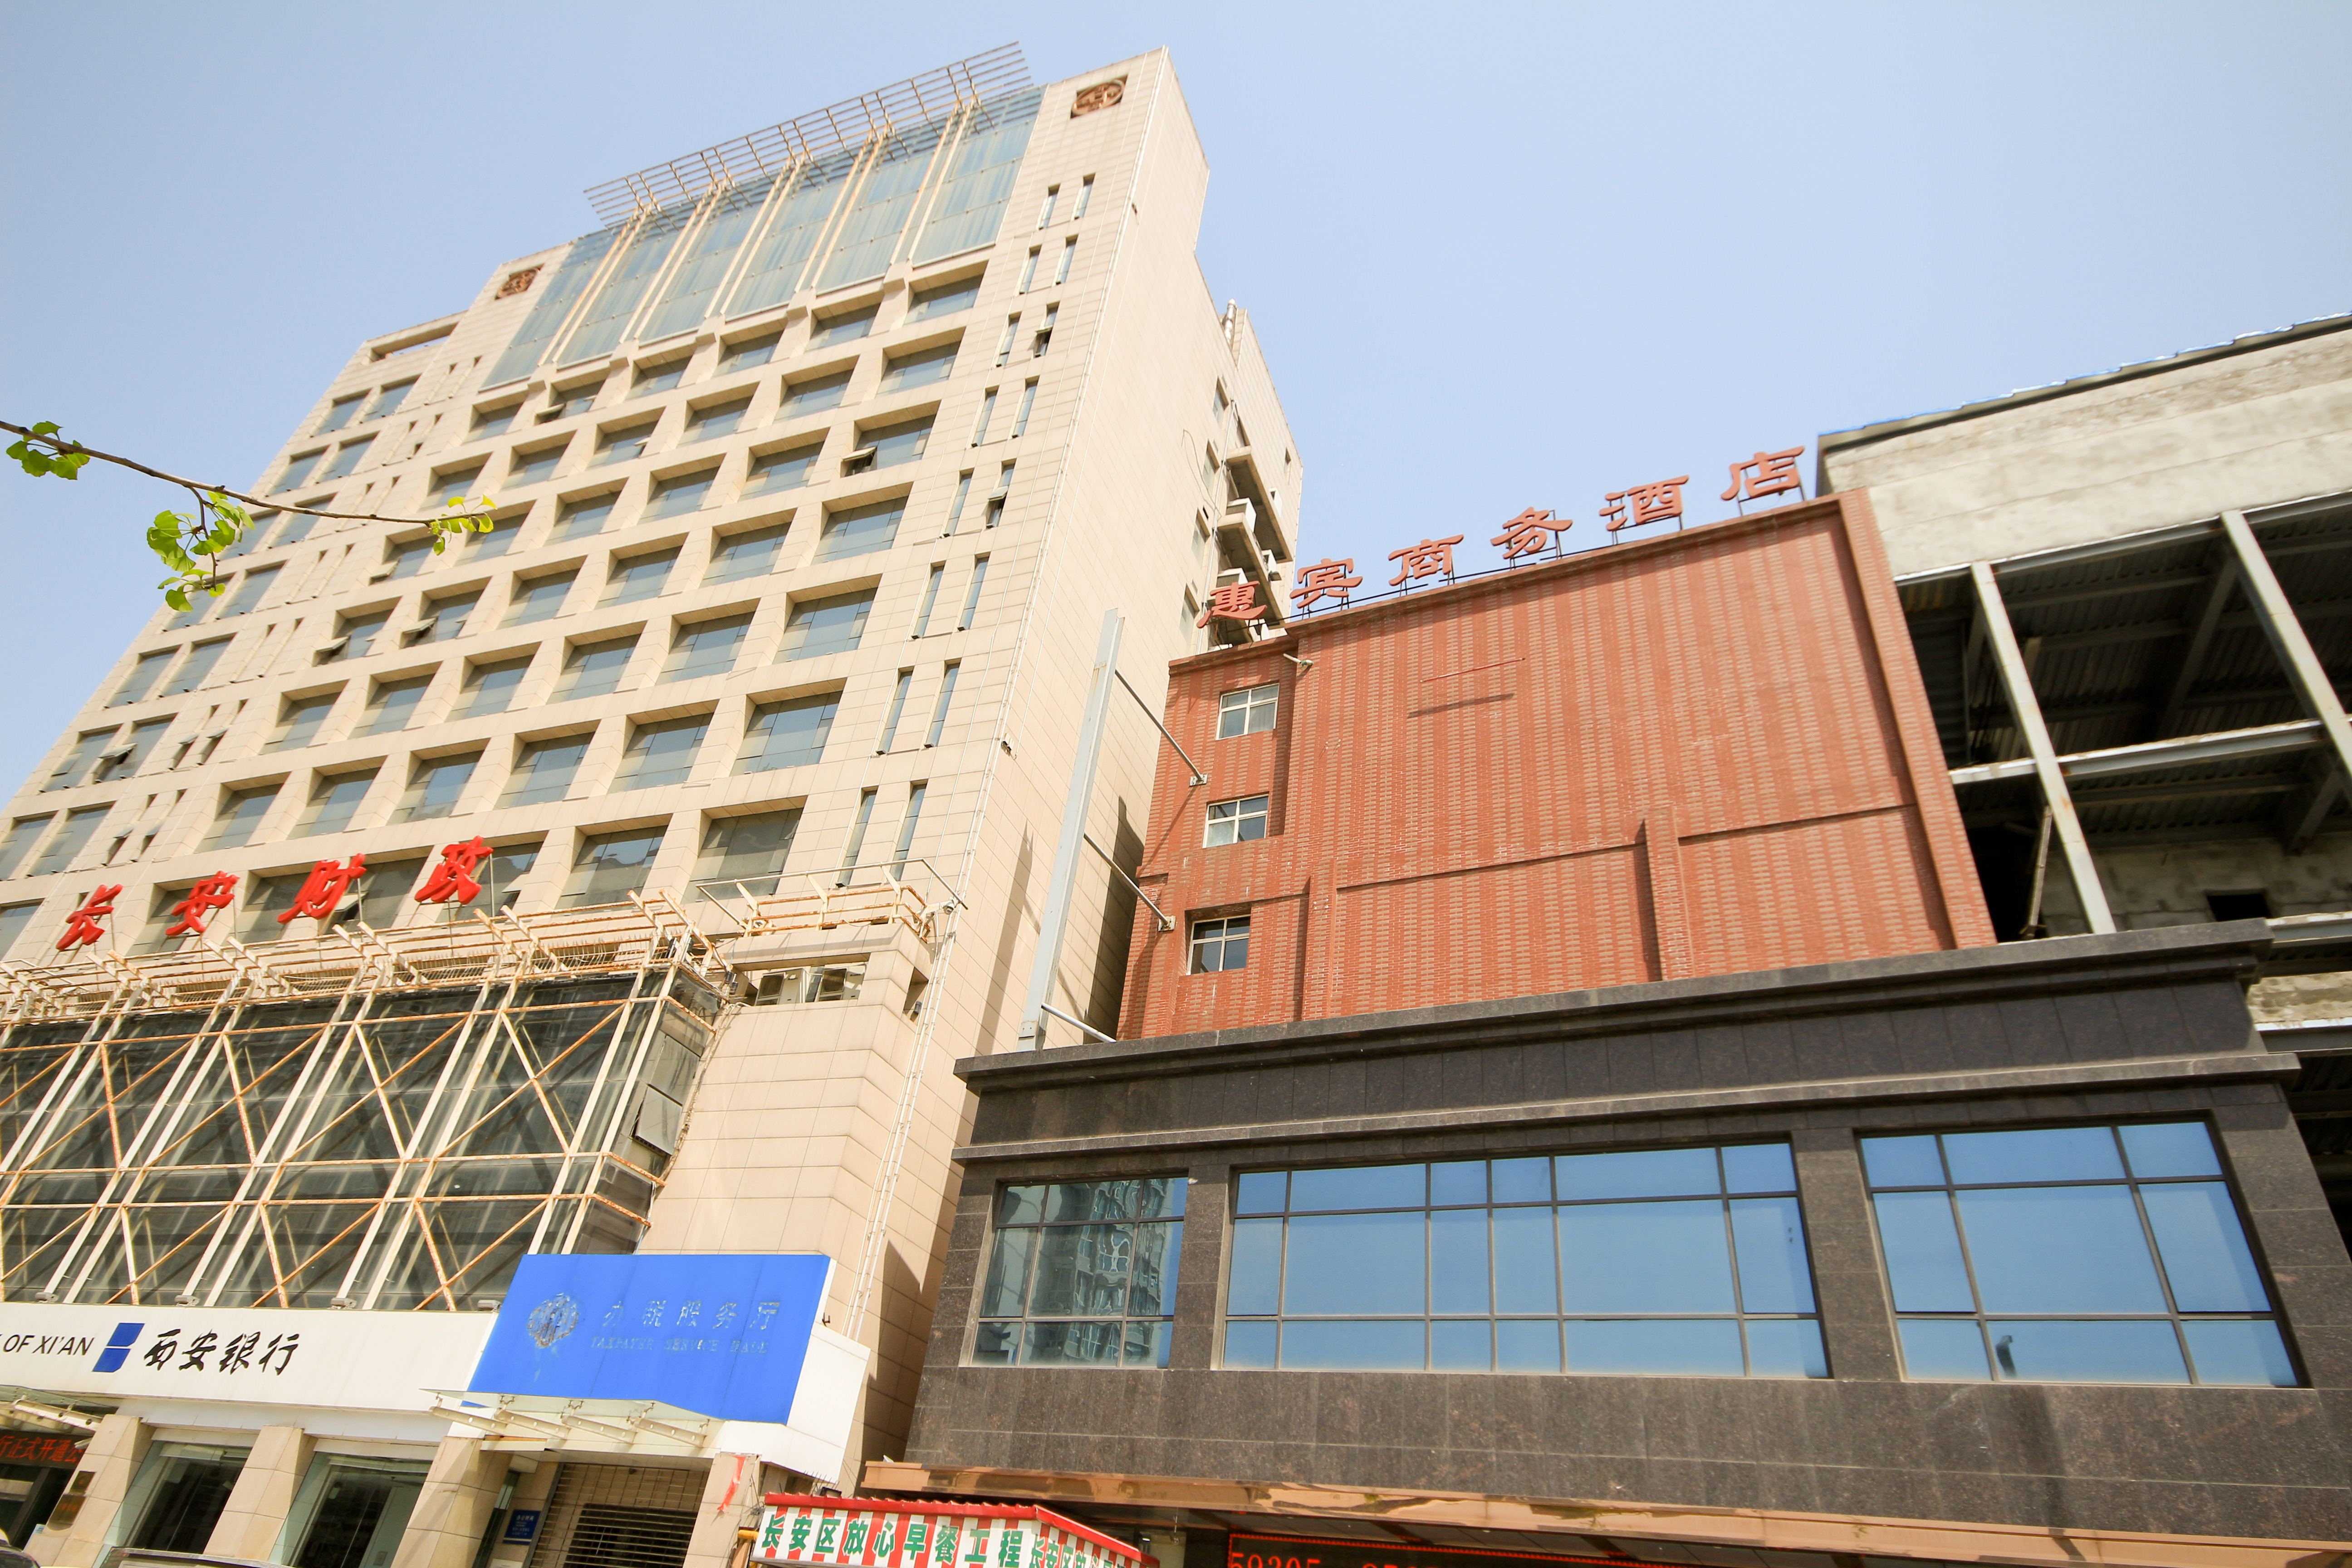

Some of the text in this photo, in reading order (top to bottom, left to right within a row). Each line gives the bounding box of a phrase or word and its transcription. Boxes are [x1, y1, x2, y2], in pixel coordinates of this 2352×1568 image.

[1196, 446, 1805, 628] 惠宾商务酒店
[603, 1299, 780, 1330] 办税服务厅
[3, 1334, 35, 1353] OF
[144, 1328, 299, 1376] 西安银行
[663, 1338, 720, 1352] SERVICE
[761, 1514, 1024, 1568] 长安区放心早餐工程
